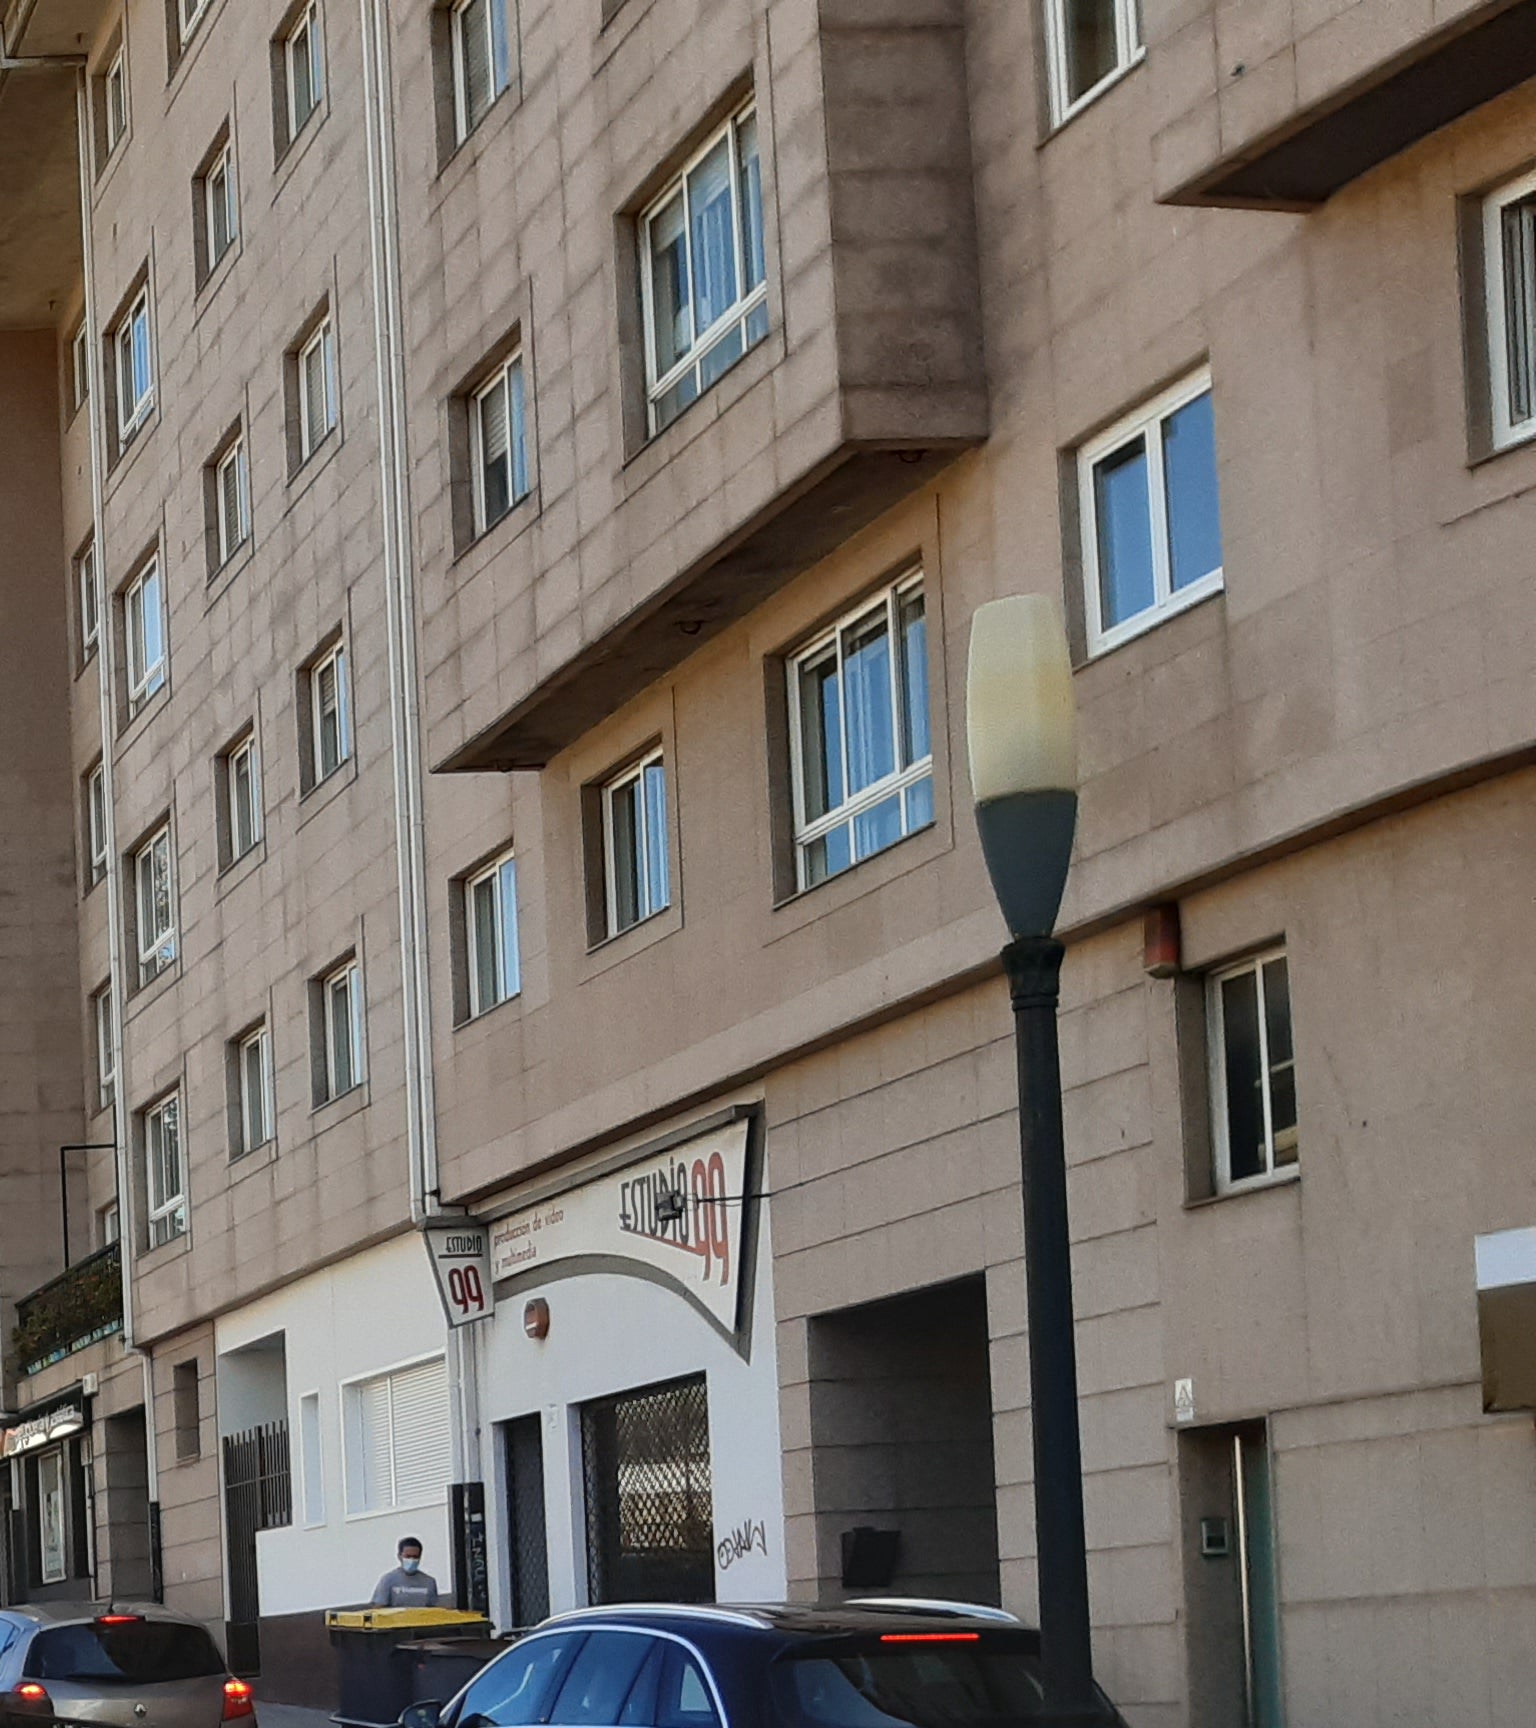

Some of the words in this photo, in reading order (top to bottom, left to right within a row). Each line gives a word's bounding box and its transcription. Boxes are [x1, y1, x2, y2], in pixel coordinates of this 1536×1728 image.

[691, 1151, 730, 1287] 99
[445, 1235, 483, 1255] ESTUDIO
[448, 1264, 485, 1315] 99
